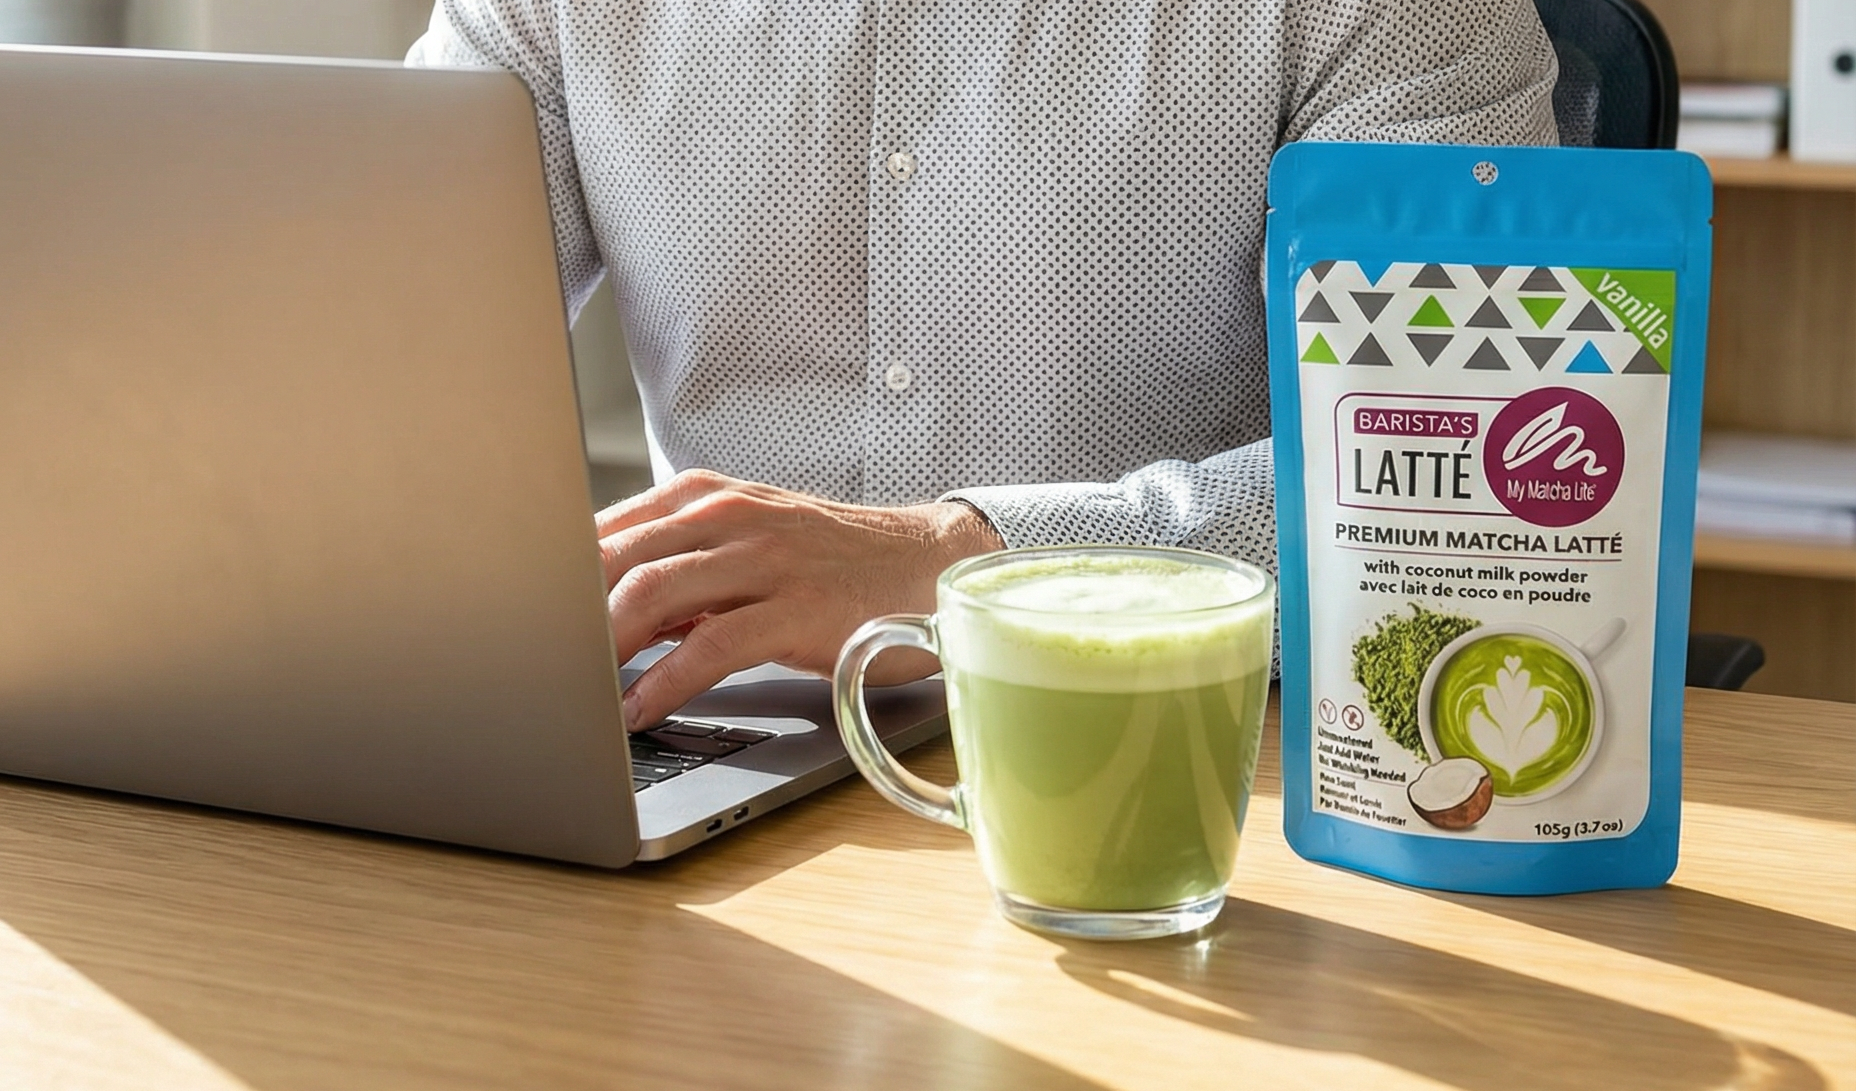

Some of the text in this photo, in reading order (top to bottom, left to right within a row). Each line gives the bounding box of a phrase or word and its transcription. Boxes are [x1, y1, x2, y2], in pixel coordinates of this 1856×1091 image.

[1596, 272, 1668, 349] vanilla
[1359, 412, 1473, 434] BARISTA'S
[1354, 440, 1472, 499] LATTÉ
[1507, 479, 1525, 502] My
[1335, 523, 1623, 554] PREMIUM MATCHA LATTÉ
[1364, 560, 1588, 585] with coconut milk powder
[1360, 579, 1591, 605] avec lait de coco en poudre
[1534, 823, 1571, 839] 105g
[1574, 821, 1601, 836] (3.7
